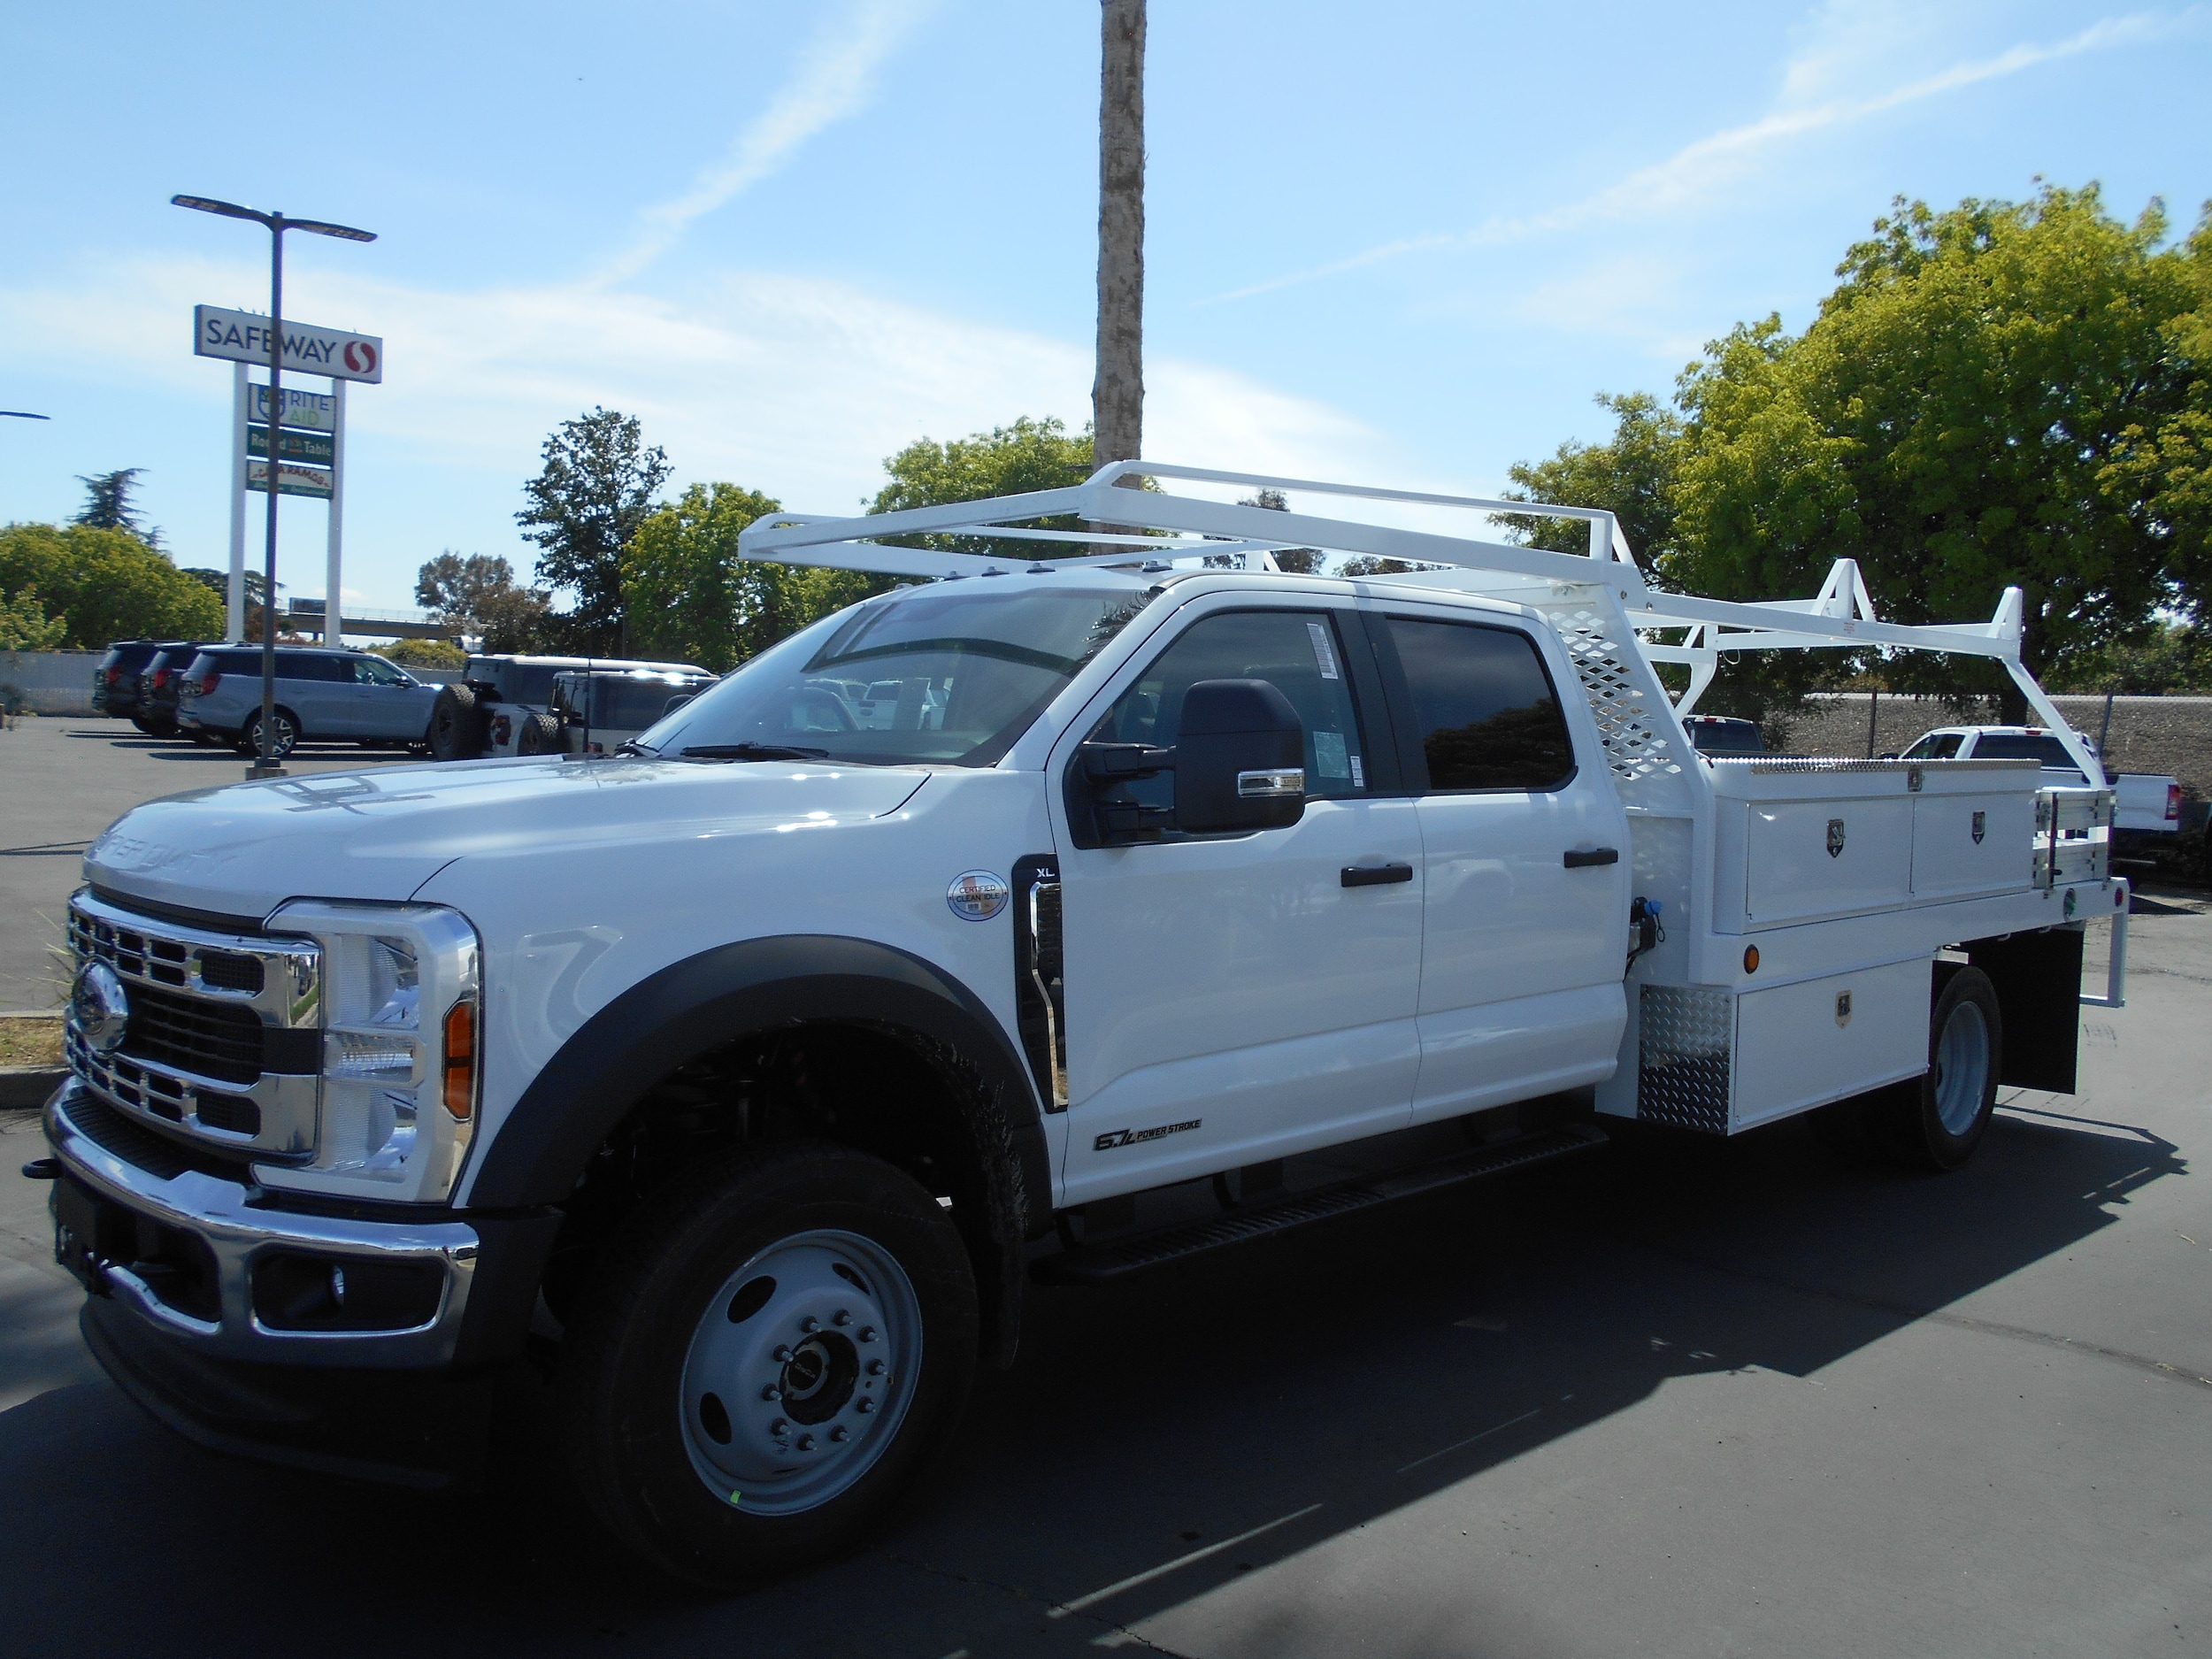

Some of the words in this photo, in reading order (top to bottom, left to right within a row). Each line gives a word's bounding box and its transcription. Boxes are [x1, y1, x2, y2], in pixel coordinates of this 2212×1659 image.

[206, 319, 337, 364] SAFEWAY
[290, 390, 330, 411] RITE
[290, 409, 319, 426] AID
[303, 441, 331, 457] Table
[1036, 867, 1056, 879] XL
[959, 885, 996, 894] CERTIFIED
[1094, 1129, 1135, 1150] 6.7L
[1137, 1125, 1167, 1140] POWER
[1168, 1119, 1201, 1133] STROKE
